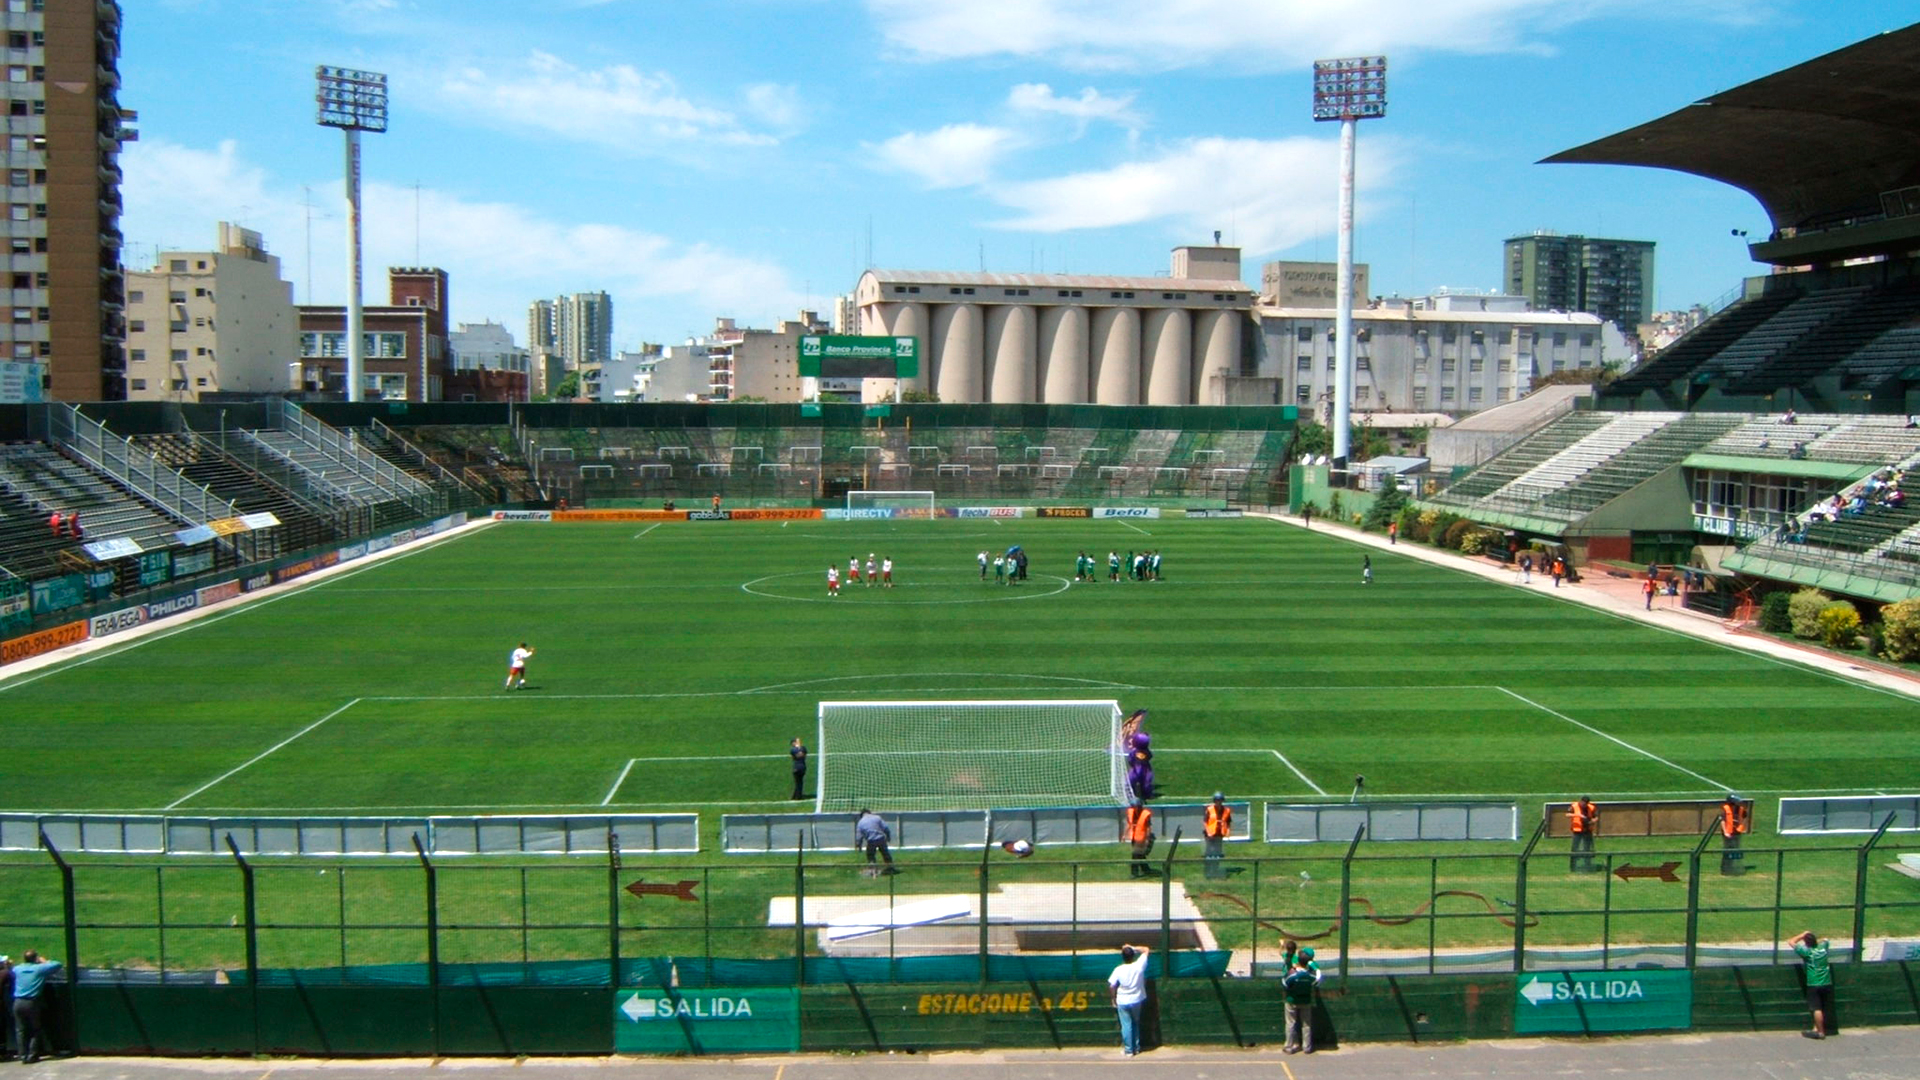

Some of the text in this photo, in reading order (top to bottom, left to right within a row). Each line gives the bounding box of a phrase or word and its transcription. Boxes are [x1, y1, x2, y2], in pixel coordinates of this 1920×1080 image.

[825, 345, 891, 353] Banco Provincia
[494, 512, 550, 520] Chevallier
[734, 510, 815, 520] 0800-999-2727
[843, 508, 891, 518] DIRECTV
[990, 508, 1016, 516] BUS
[1104, 508, 1148, 517] Befol
[1702, 518, 1729, 534] CLUB
[150, 594, 194, 618] PHILCO
[1, 625, 82, 661] 0800-999-2727
[1555, 980, 1643, 1000] SALIDA
[657, 997, 752, 1017] SALIDA
[918, 992, 1033, 1015] ESTACIONE
